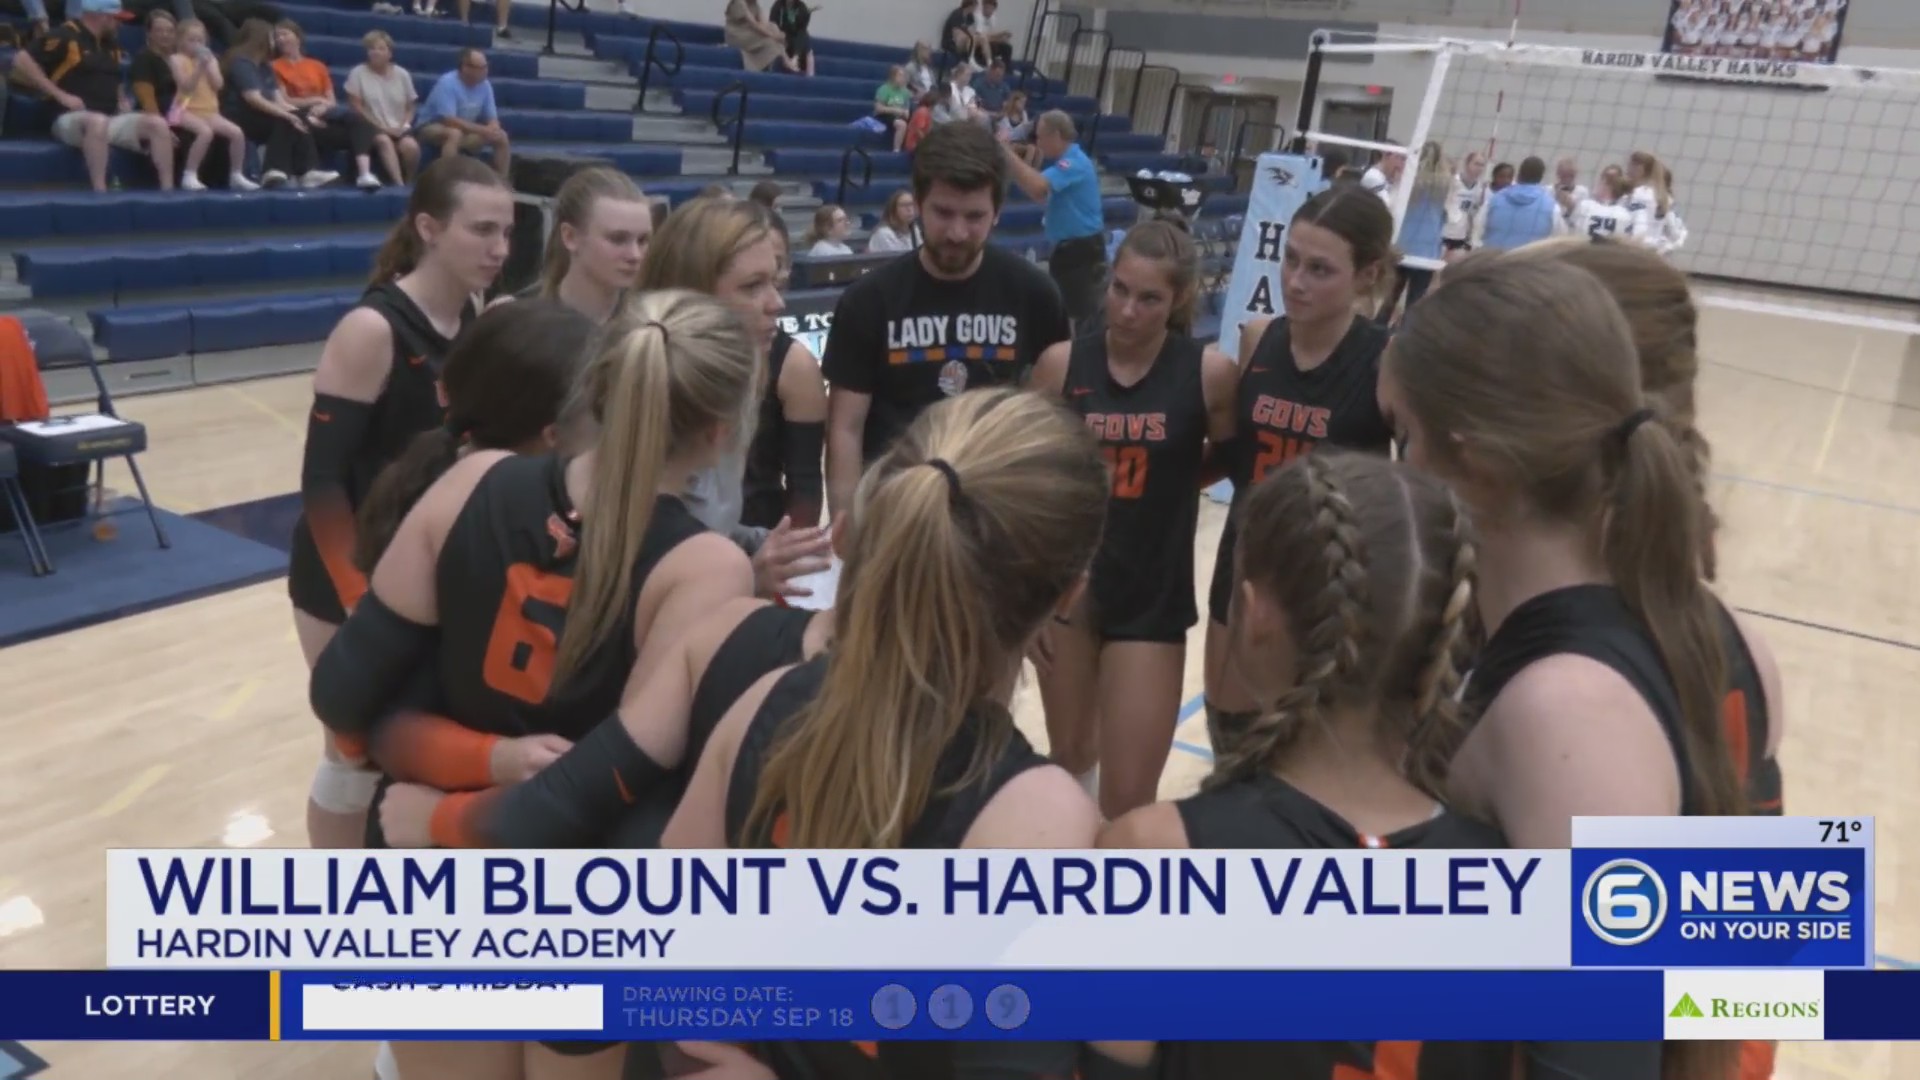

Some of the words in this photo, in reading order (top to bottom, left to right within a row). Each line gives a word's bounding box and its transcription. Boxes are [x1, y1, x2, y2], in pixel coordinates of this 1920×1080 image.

[1581, 50, 1645, 68] HARDIN
[1652, 55, 1722, 73] VALLEY
[1726, 61, 1798, 78] HAWKS
[887, 315, 949, 349] LADY
[956, 313, 1017, 345] GOVS
[1086, 412, 1167, 441] GOVS
[1252, 394, 1331, 438] GOVS
[482, 562, 573, 705] 6
